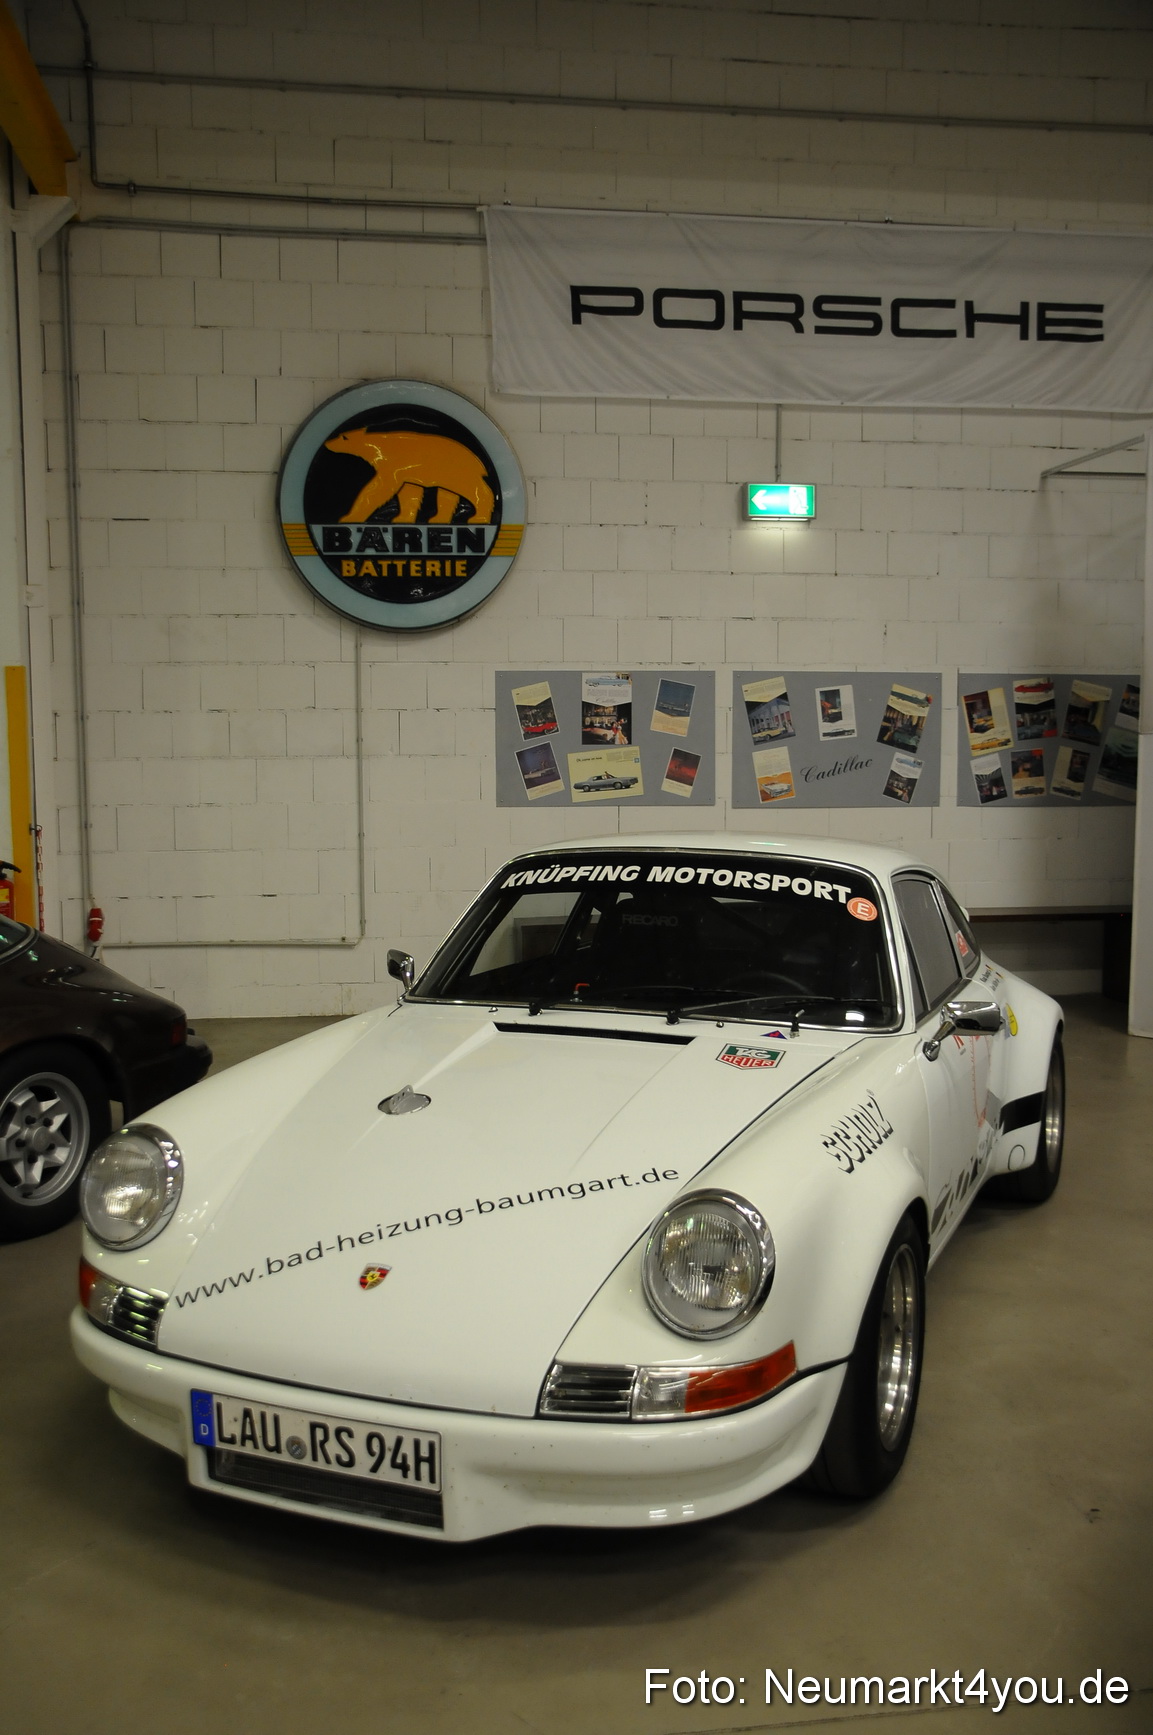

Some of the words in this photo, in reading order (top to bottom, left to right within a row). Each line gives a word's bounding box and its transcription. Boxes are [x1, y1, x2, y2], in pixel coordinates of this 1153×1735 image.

[570, 285, 1104, 342] PORSCHE
[322, 527, 485, 553] BÄREN
[342, 559, 468, 577] BATTERIE
[800, 755, 873, 784] Cadillac
[501, 865, 641, 889] KNÜPFING
[646, 866, 852, 904] MOTORSPORT
[622, 913, 678, 927] RECARO
[857, 902, 869, 916] E
[722, 1055, 774, 1067] HEUER
[735, 1047, 772, 1059] TAG
[175, 1166, 679, 1308] www.bad-heizung-baumgart.de
[200, 1423, 209, 1436] D
[216, 1401, 282, 1454] LAU
[309, 1421, 356, 1468] RS
[366, 1431, 436, 1484] 94H
